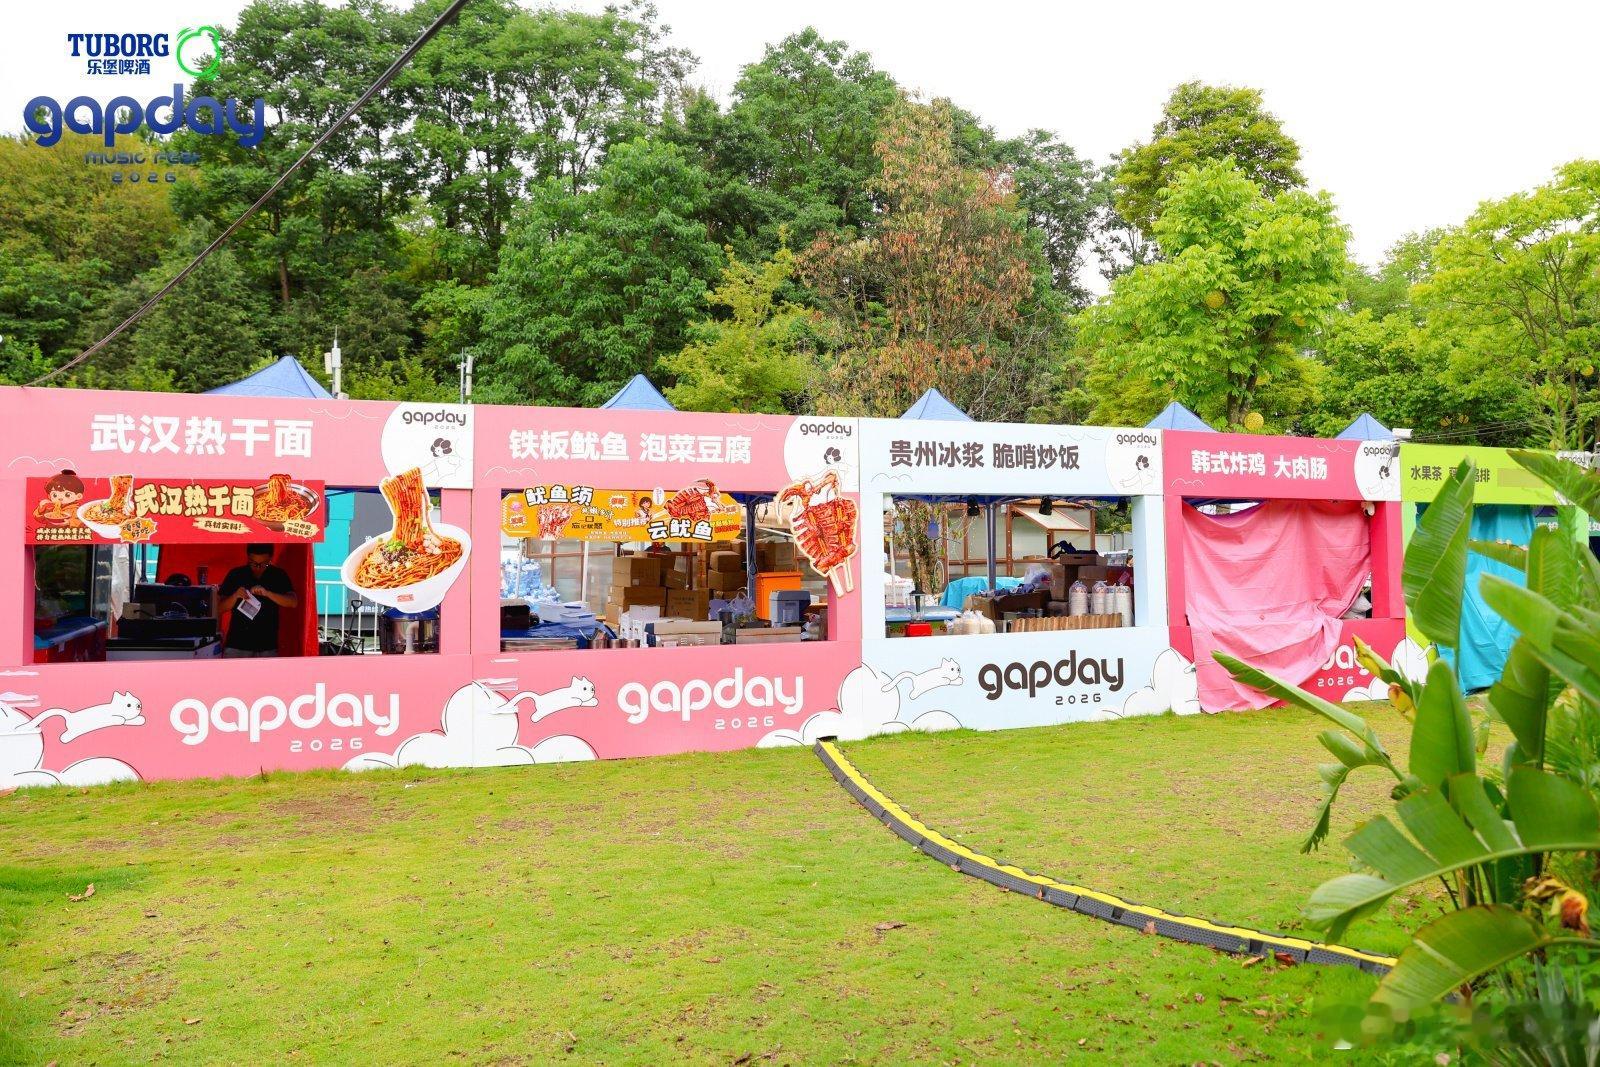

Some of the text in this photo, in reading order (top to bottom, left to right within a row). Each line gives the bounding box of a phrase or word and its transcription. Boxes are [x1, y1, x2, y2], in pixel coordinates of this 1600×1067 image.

[402, 409, 467, 426] gapday
[90, 413, 313, 459] 武汉热干面
[799, 421, 852, 437] gapday
[1116, 432, 1157, 446] gapday
[508, 429, 753, 465] 铁板鱿鱼 泡菜豆腐
[889, 440, 1080, 471] 贵州冰浆 脆哨炒饭
[1363, 444, 1392, 457] gapda
[1191, 449, 1328, 480] 韩式炸鸡 大肉肠
[1410, 465, 1443, 481] 水果茶
[133, 485, 255, 518] 武汉热干面
[525, 485, 594, 507] 鱿鱼须
[647, 518, 714, 541] 云鱿鱼
[978, 650, 1124, 701] gapday
[1317, 676, 1354, 687] 2026
[617, 667, 804, 725] gapday
[1055, 693, 1101, 705] 2026
[169, 683, 399, 746] gapday
[714, 715, 774, 730] 2026
[290, 738, 363, 753] 2026
